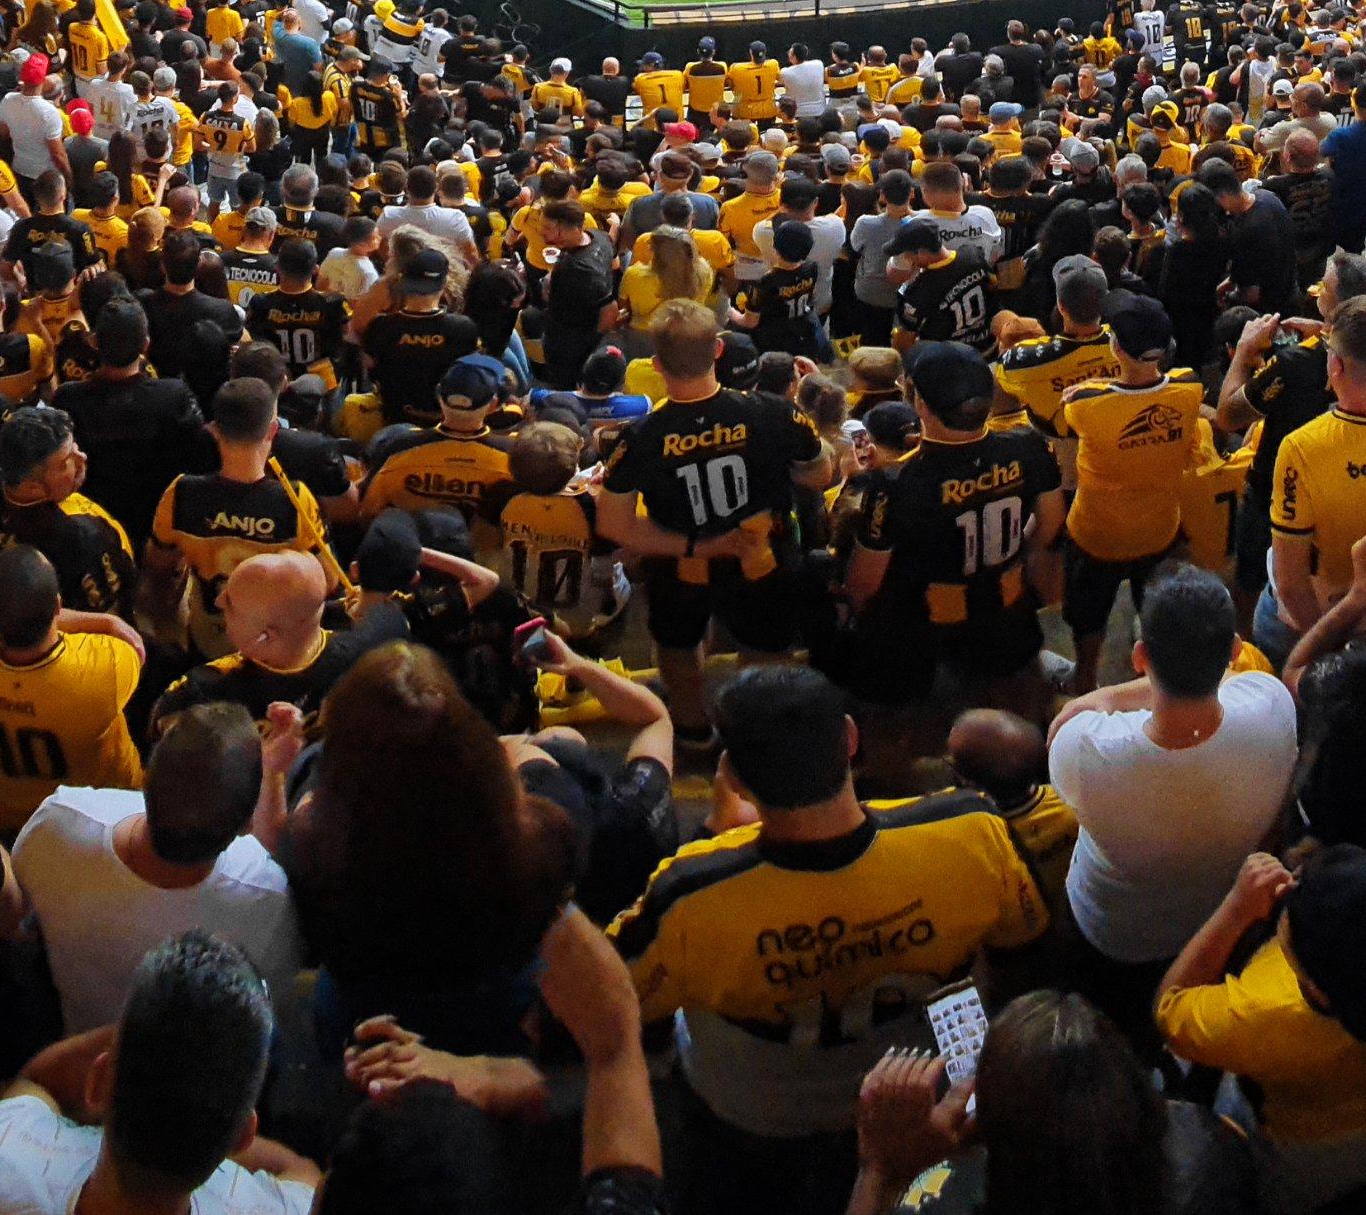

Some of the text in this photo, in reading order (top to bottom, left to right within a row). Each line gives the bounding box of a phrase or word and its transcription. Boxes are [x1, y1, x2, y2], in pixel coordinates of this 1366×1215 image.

[937, 226, 984, 242] Rocha
[227, 267, 277, 284] TECNOCOLA
[948, 284, 987, 330] 10
[275, 327, 316, 364] 10
[398, 333, 445, 349] ANJO
[661, 420, 748, 458] Rocha
[405, 471, 485, 498] elian
[675, 454, 749, 526] 10
[941, 458, 1022, 507] Rocha
[210, 511, 276, 537] ANJO
[954, 494, 1023, 577] 10
[755, 915, 847, 960] neo
